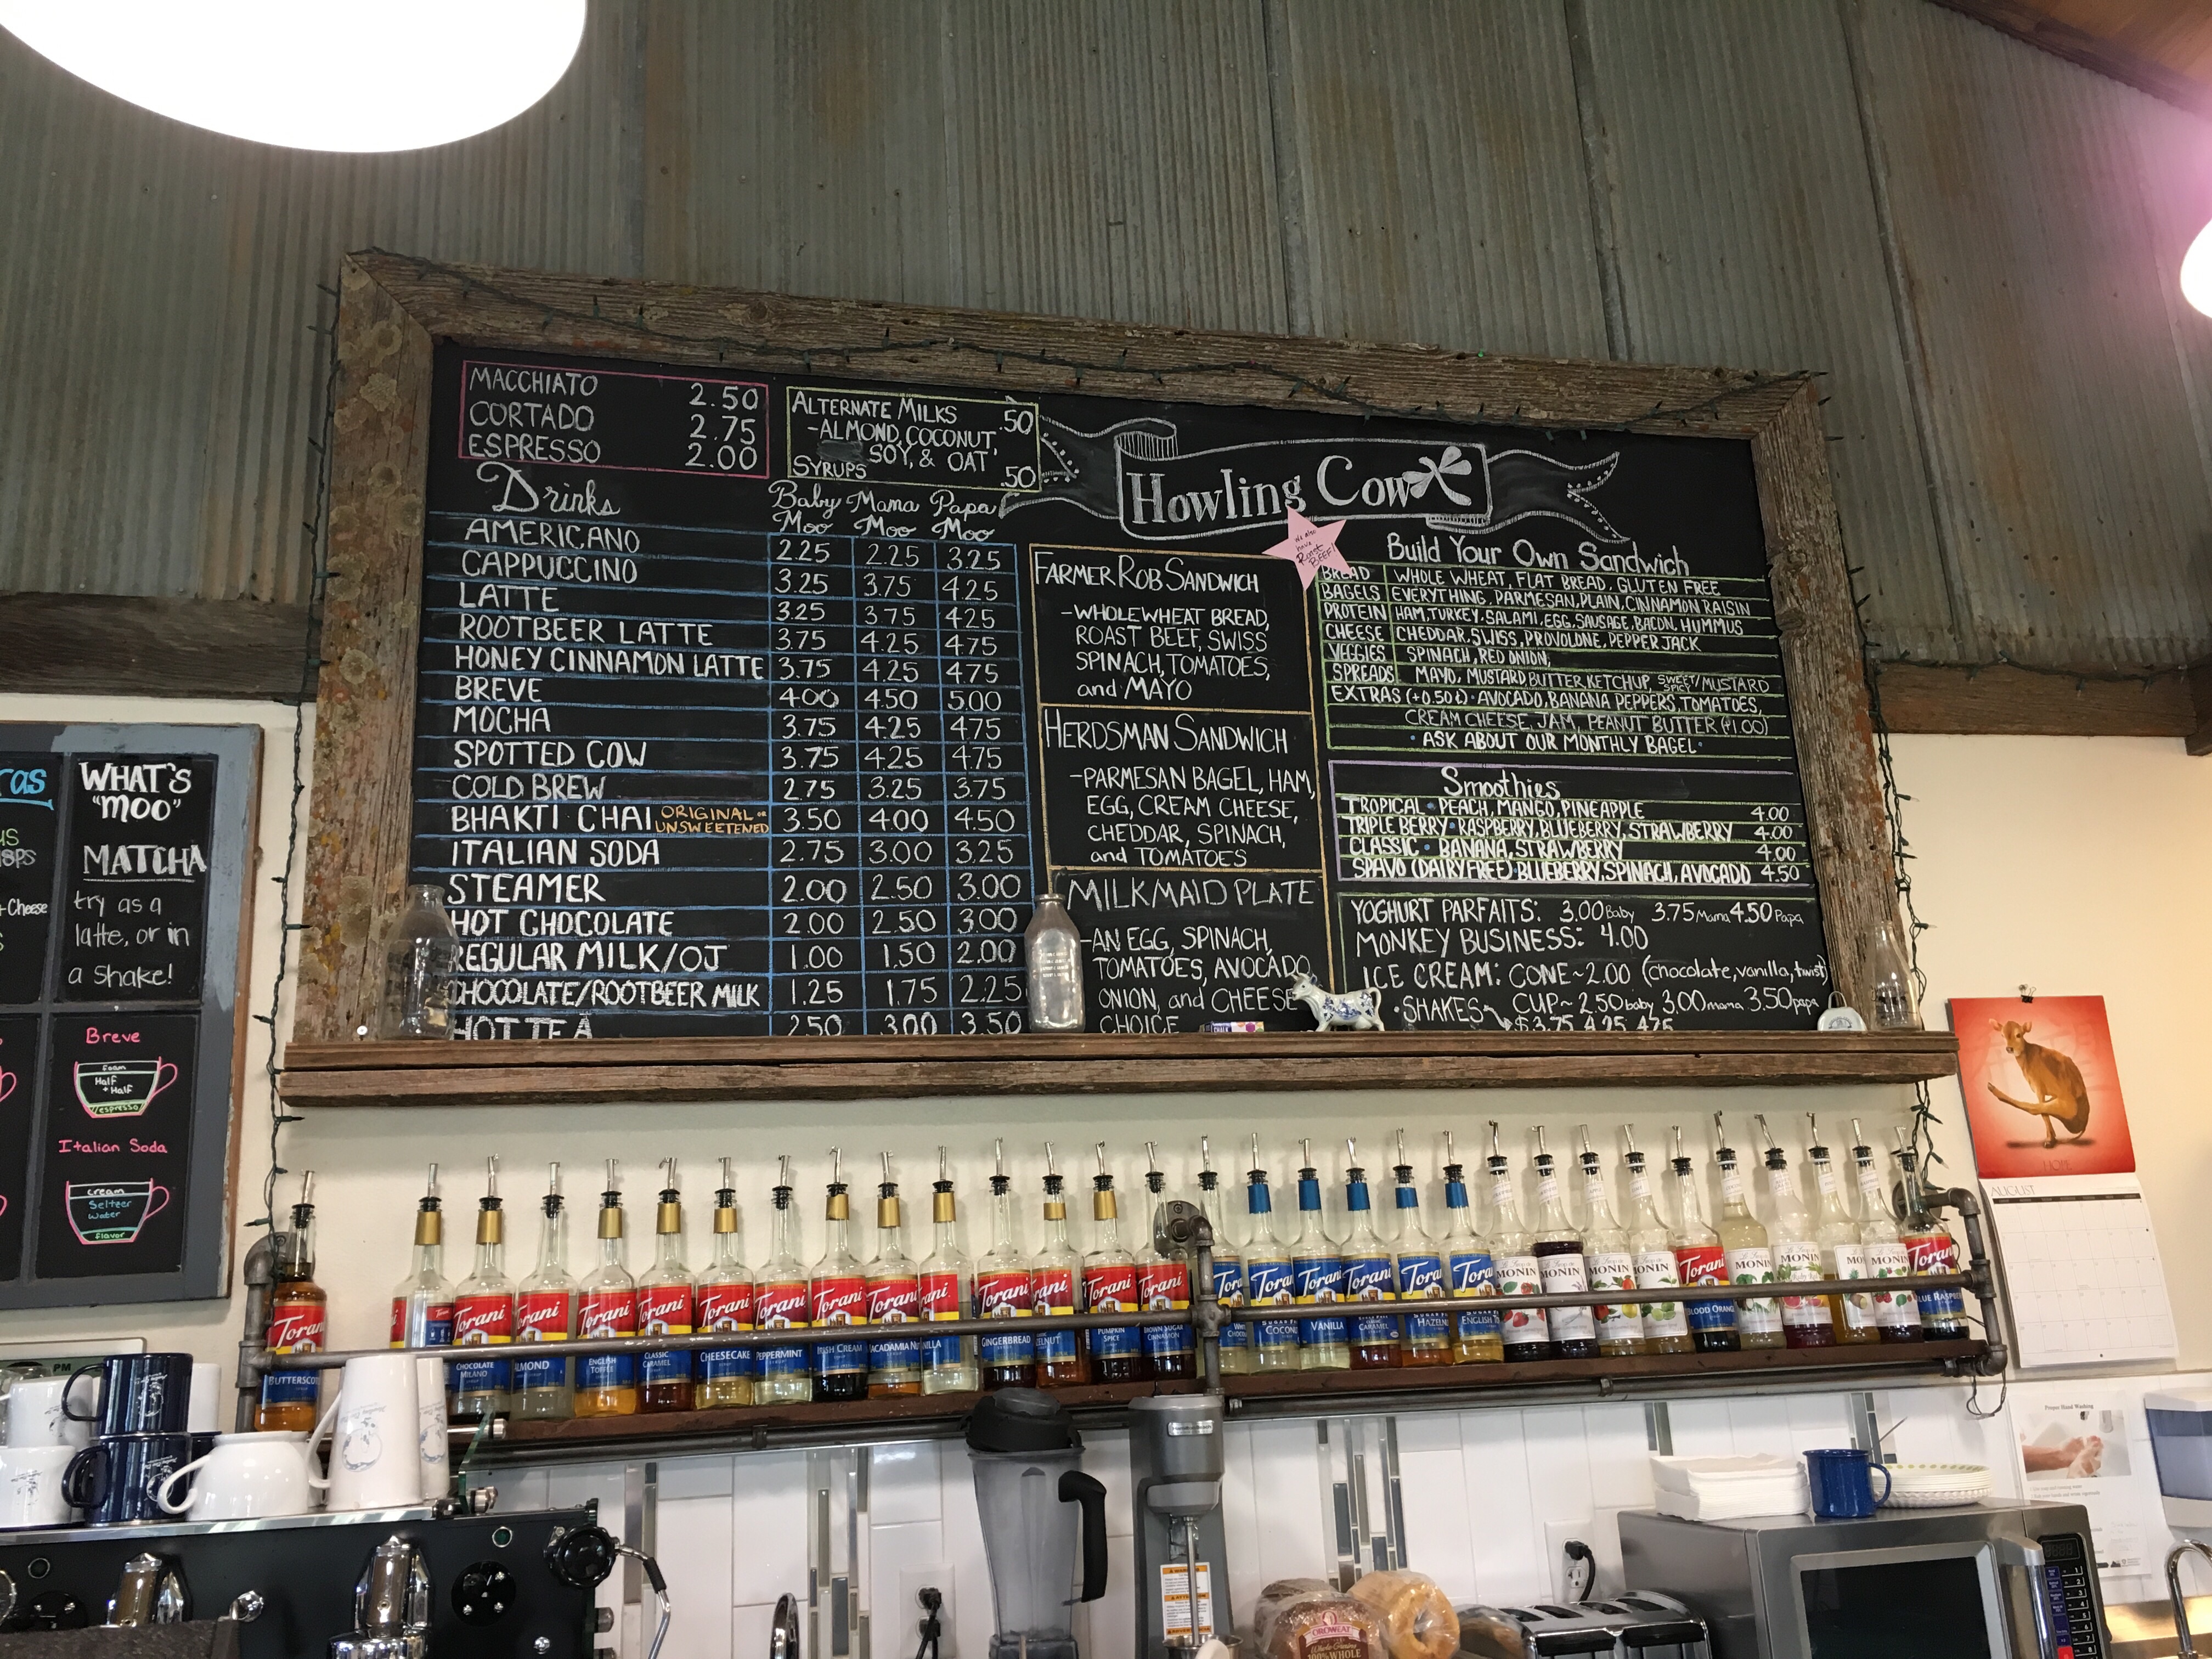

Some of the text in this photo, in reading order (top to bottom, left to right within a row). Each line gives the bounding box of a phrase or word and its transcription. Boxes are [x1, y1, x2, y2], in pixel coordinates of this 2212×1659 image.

[470, 368, 758, 410] MACCHIATO 2.50
[792, 391, 891, 419] ALTERNATE
[898, 398, 957, 424] MILKS
[470, 401, 755, 444] CORTADO 2.75
[469, 433, 757, 469] ESPRESSO 2.00
[919, 449, 935, 467] &
[947, 451, 989, 472] OAT
[793, 455, 867, 478] SYRUPS
[477, 461, 620, 516] Drinks
[768, 480, 997, 521] Baby Mama Papa
[1126, 455, 1410, 524] Howling Cow
[772, 511, 995, 542] Moo Moo Moo
[465, 518, 1001, 571] AMERICANO 2.25 2.25 3.25
[1387, 532, 1689, 575] Build Your Own Sandwich
[462, 550, 998, 601] CAPPUCCINO 3.25 3.75 4.25
[1035, 551, 1259, 593] FARMER ROB SANDWICH
[1394, 569, 1721, 596] WHOLE GLUTEN FREE
[459, 582, 559, 612] LATTE
[1321, 583, 1750, 616] BAGELS RAISIN
[459, 613, 713, 646] ROOTBEER LATTE
[1324, 602, 1743, 635] PROTEIN HUMMUS
[1076, 625, 1142, 647] ROAST
[1325, 624, 1701, 652] CHEESE PEPPER JACK
[454, 645, 765, 680] HONEY CINNAMON LATTE
[1328, 644, 1385, 661] VEGGIES
[1333, 665, 1394, 682] SPREADS
[454, 675, 543, 702] BREVE
[1077, 676, 1192, 701] and MAYO
[1331, 686, 1401, 703] EXTRAS
[453, 706, 551, 735] MOCHA
[1045, 709, 1288, 754] HERDSMAN SANDWICH
[1406, 709, 1717, 733] CREAM PEANUT BUTTER
[453, 740, 647, 768] SPOTTED COW
[1423, 732, 1696, 754] ASK ABOUT OUR MONTHLY BAGEL
[452, 774, 606, 800] COLD BREW
[1441, 766, 1560, 800] Smoothies
[452, 804, 651, 832] BHAKTI CHAI
[661, 805, 754, 821] ORIGINAL
[1138, 794, 1211, 816] CREAM
[1341, 797, 1790, 822] TROPICAL 4.00
[656, 820, 769, 834] UNSWEETENED
[1342, 816, 1448, 836] TRIPLE BERRY
[452, 839, 660, 867] ITALIAN SODA
[1091, 846, 1247, 867] and TOMATOES
[1350, 837, 1419, 856] CLASSIC
[83, 844, 207, 876] MATCHA
[1352, 859, 1406, 878] SPAVO
[447, 872, 1022, 905] STEAMER 2.00 2.50 3.00
[1234, 878, 1316, 907] PLATE
[74, 890, 161, 917] try as a
[1351, 898, 1695, 924] YOGHURT Baby 3.75
[137, 927, 160, 944] or
[168, 922, 189, 946] in
[520, 909, 675, 937] CHOCOLATE
[1356, 922, 1648, 958] MONKEY 4.00
[1363, 964, 1403, 989] ICE
[1403, 995, 1483, 1023] SHAKES
[86, 1027, 140, 1044] Breve
[99, 1104, 139, 1114] espresso
[59, 1138, 167, 1153] Italian Soda
[89, 1200, 132, 1209] Seltzer
[1991, 1186, 2034, 1197] AUGUST
[1497, 1268, 1536, 1278] MONIN
[814, 1288, 863, 1321] Torani
[454, 1304, 506, 1339] Torani
[579, 1300, 630, 1336] Torani
[1311, 1321, 1344, 1331] VANILLA
[817, 1344, 862, 1354] IRISH CREAM
[981, 1335, 1031, 1347] GINGERBREAD
[53, 1363, 71, 1372] PM
[456, 1362, 494, 1370] CHOCOLATE
[701, 1351, 751, 1361] CHEESECAKE
[756, 1350, 803, 1361] PEPPERMINT
[1312, 1626, 1351, 1637] OROWEAT
[1330, 1649, 1361, 1659] WHOLE
